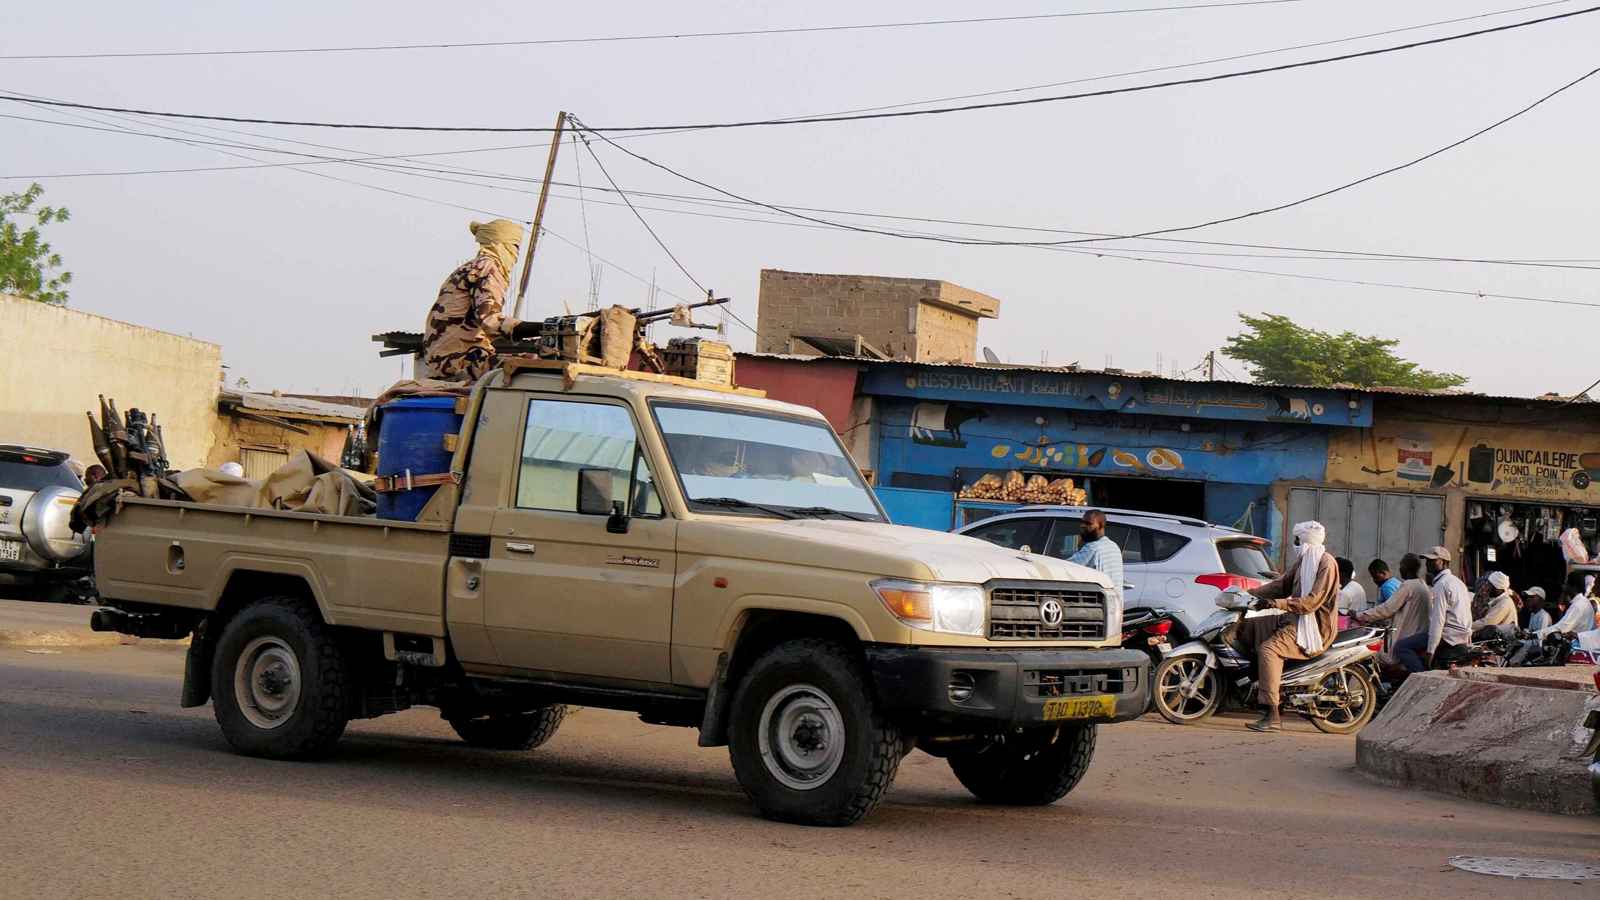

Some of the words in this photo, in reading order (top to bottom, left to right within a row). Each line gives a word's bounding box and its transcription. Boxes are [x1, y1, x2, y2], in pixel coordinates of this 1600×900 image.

[918, 371, 1025, 394] RESTAURANT
[1503, 464, 1529, 476] ROND
[1536, 466, 1568, 480] POINT
